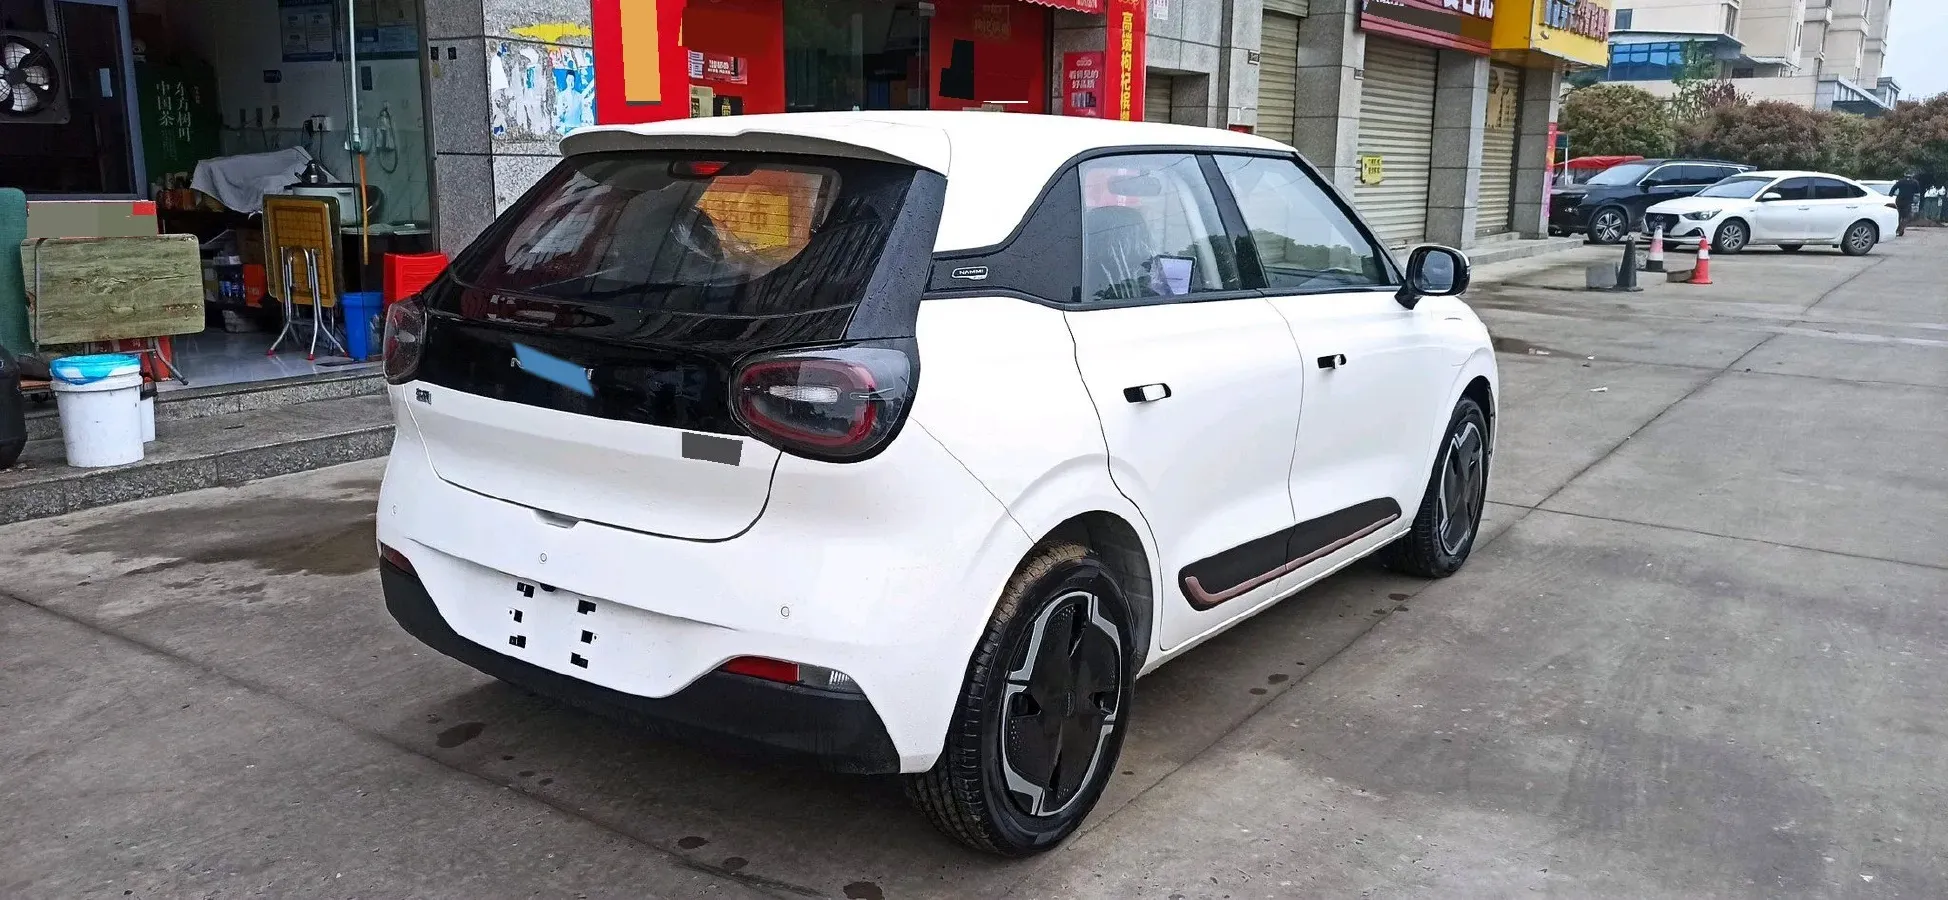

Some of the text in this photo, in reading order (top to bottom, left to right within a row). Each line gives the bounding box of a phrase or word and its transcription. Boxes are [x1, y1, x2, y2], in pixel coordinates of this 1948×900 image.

[1072, 80, 1096, 89] 好品质
[155, 80, 176, 127] 中国茶
